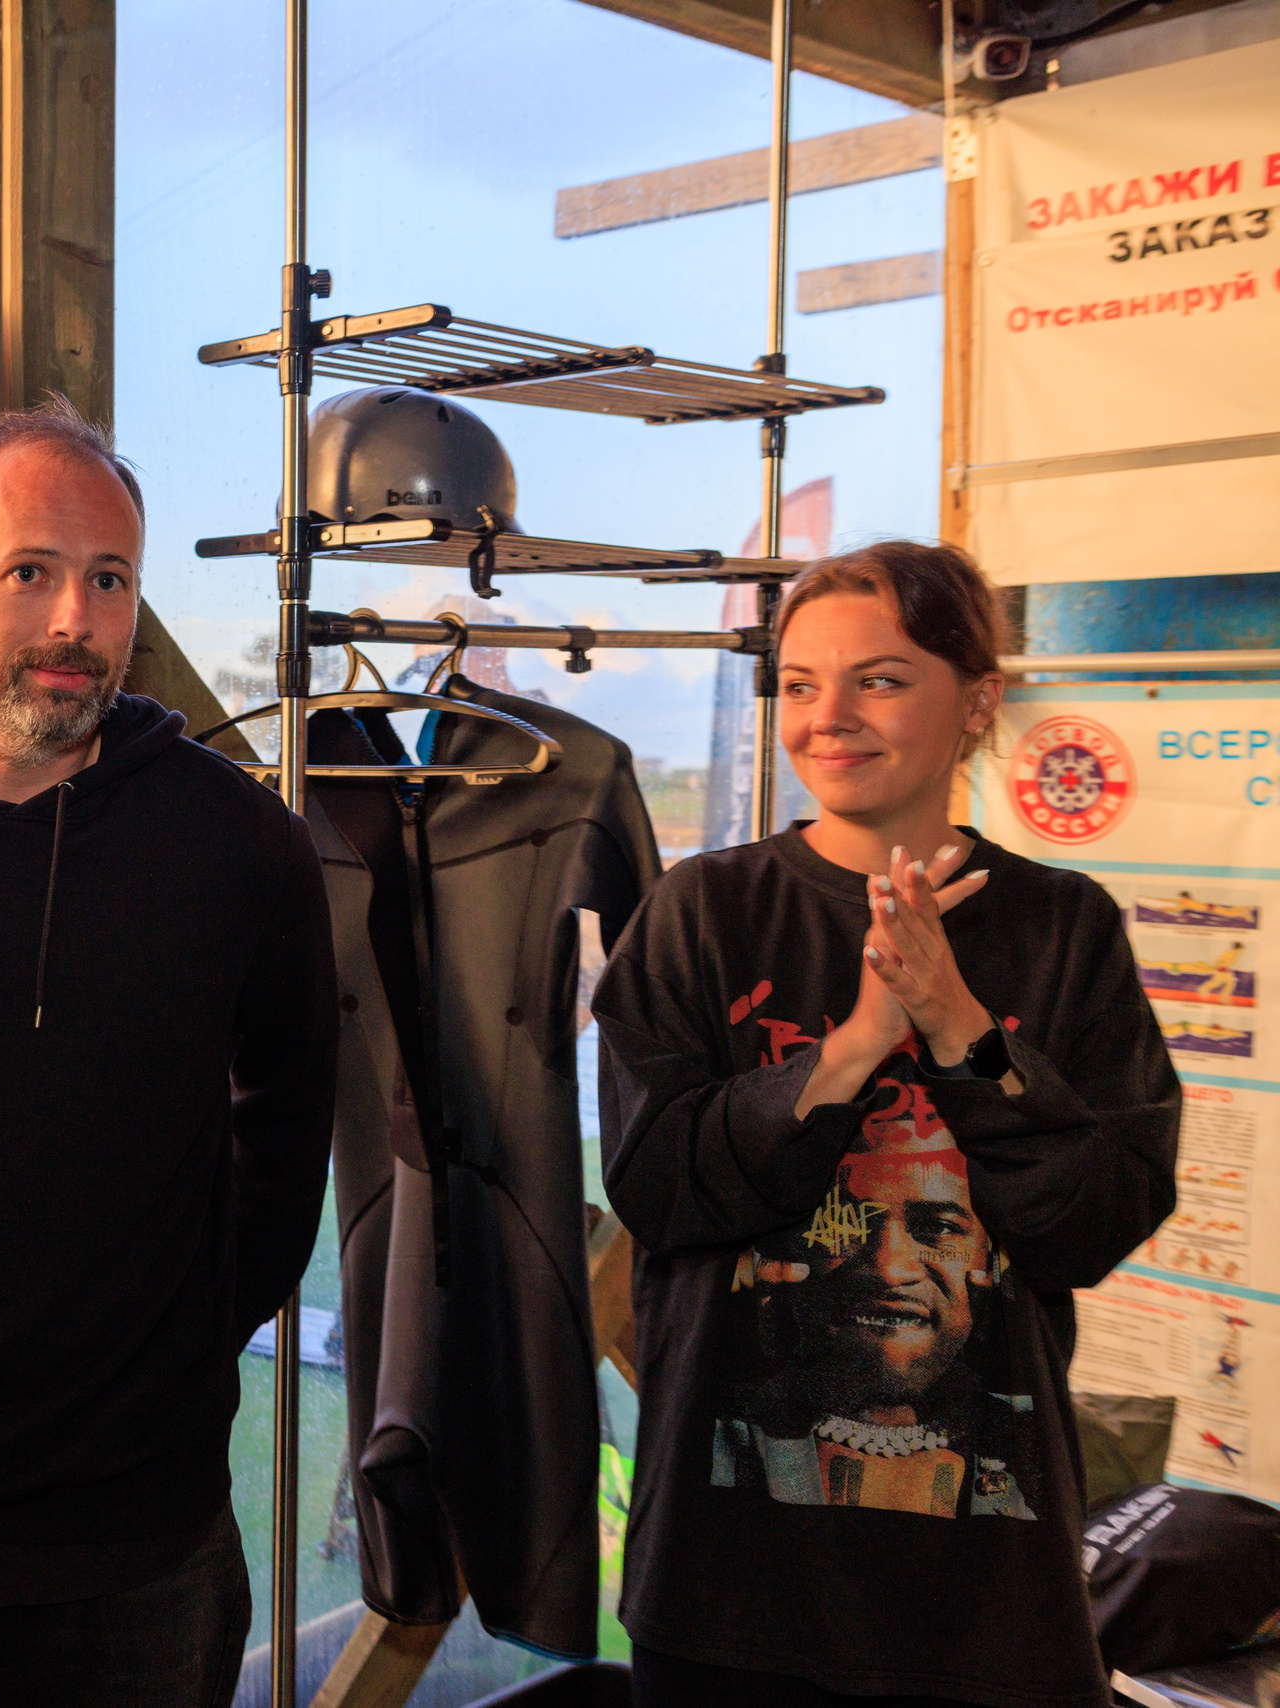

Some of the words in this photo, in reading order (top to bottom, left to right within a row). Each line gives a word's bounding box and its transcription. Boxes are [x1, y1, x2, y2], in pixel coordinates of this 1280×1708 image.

[1027, 159, 1243, 230] ЗАКАЖИ
[1108, 207, 1273, 263] ЗАКАЗ
[1006, 270, 1259, 333] Отсканируй
[1158, 729, 1280, 760] ВСЕР
